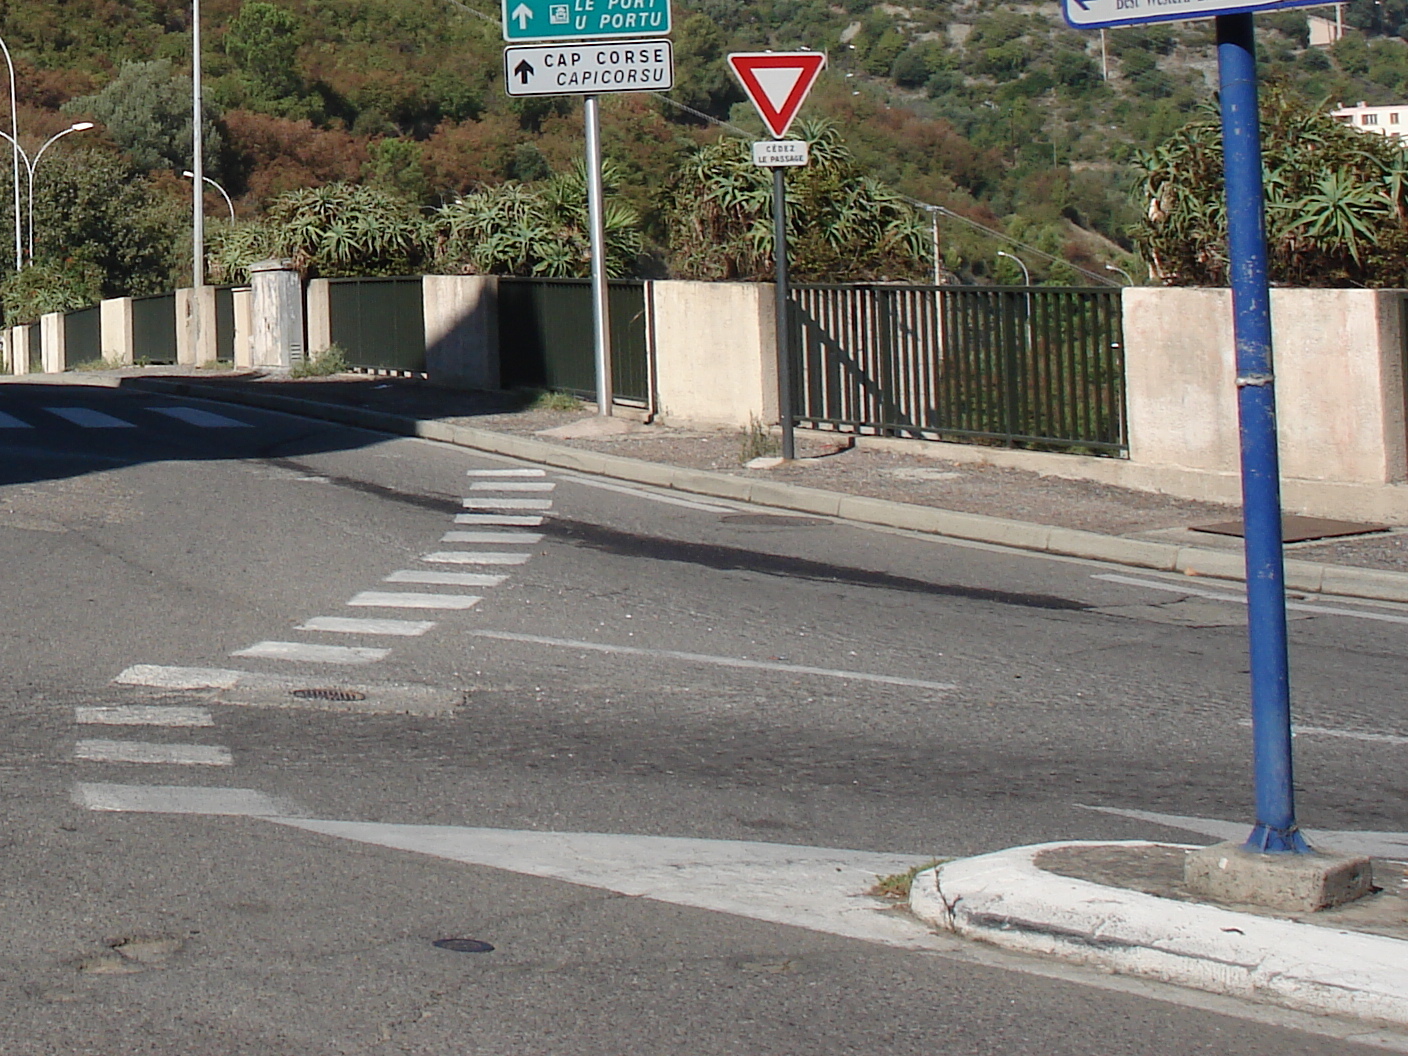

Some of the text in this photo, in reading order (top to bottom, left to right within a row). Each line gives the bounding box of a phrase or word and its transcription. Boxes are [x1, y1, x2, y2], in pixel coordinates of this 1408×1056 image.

[575, 11, 662, 30] U PORTU
[544, 49, 664, 67] CAP CORSE
[557, 67, 665, 86] CAPICORSU
[770, 155, 804, 163] PASSAGE
